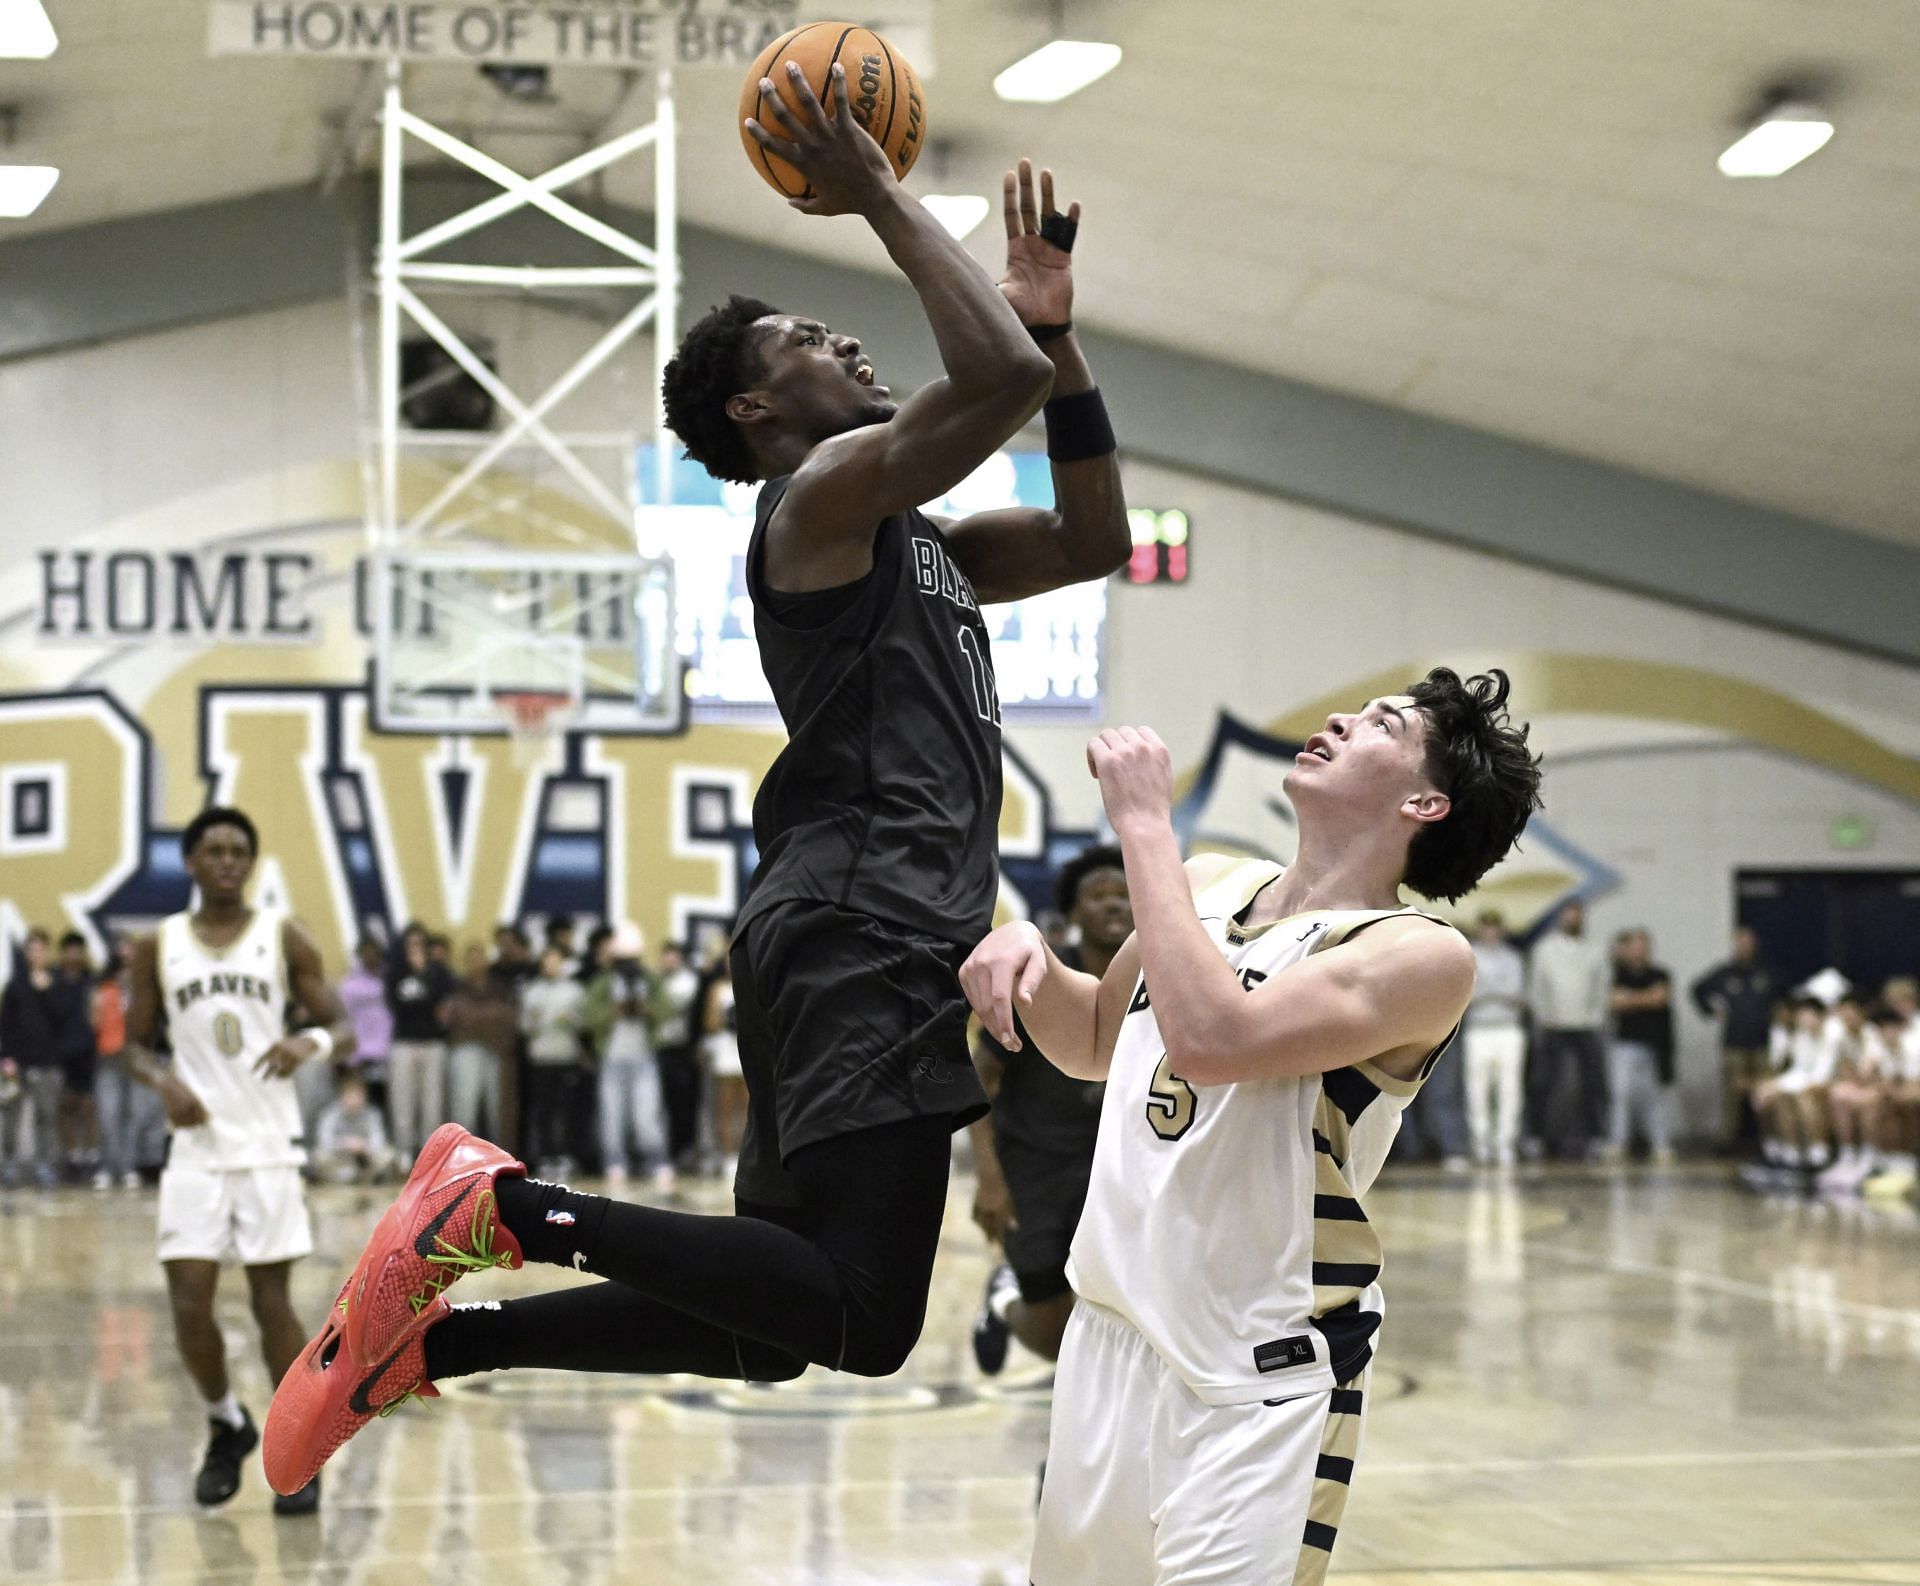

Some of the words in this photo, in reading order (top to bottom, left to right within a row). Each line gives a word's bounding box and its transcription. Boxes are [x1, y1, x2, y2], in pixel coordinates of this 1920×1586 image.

[253, 3, 435, 54] HOME
[453, 7, 531, 57] OF
[549, 10, 655, 60] THE
[676, 12, 800, 63] BRA
[850, 54, 882, 131] son
[37, 551, 313, 636] HOME
[177, 973, 270, 1014] BRAVES
[214, 1010, 243, 1058] 0
[1146, 1050, 1198, 1141] 5
[1292, 1344, 1307, 1356] XL
